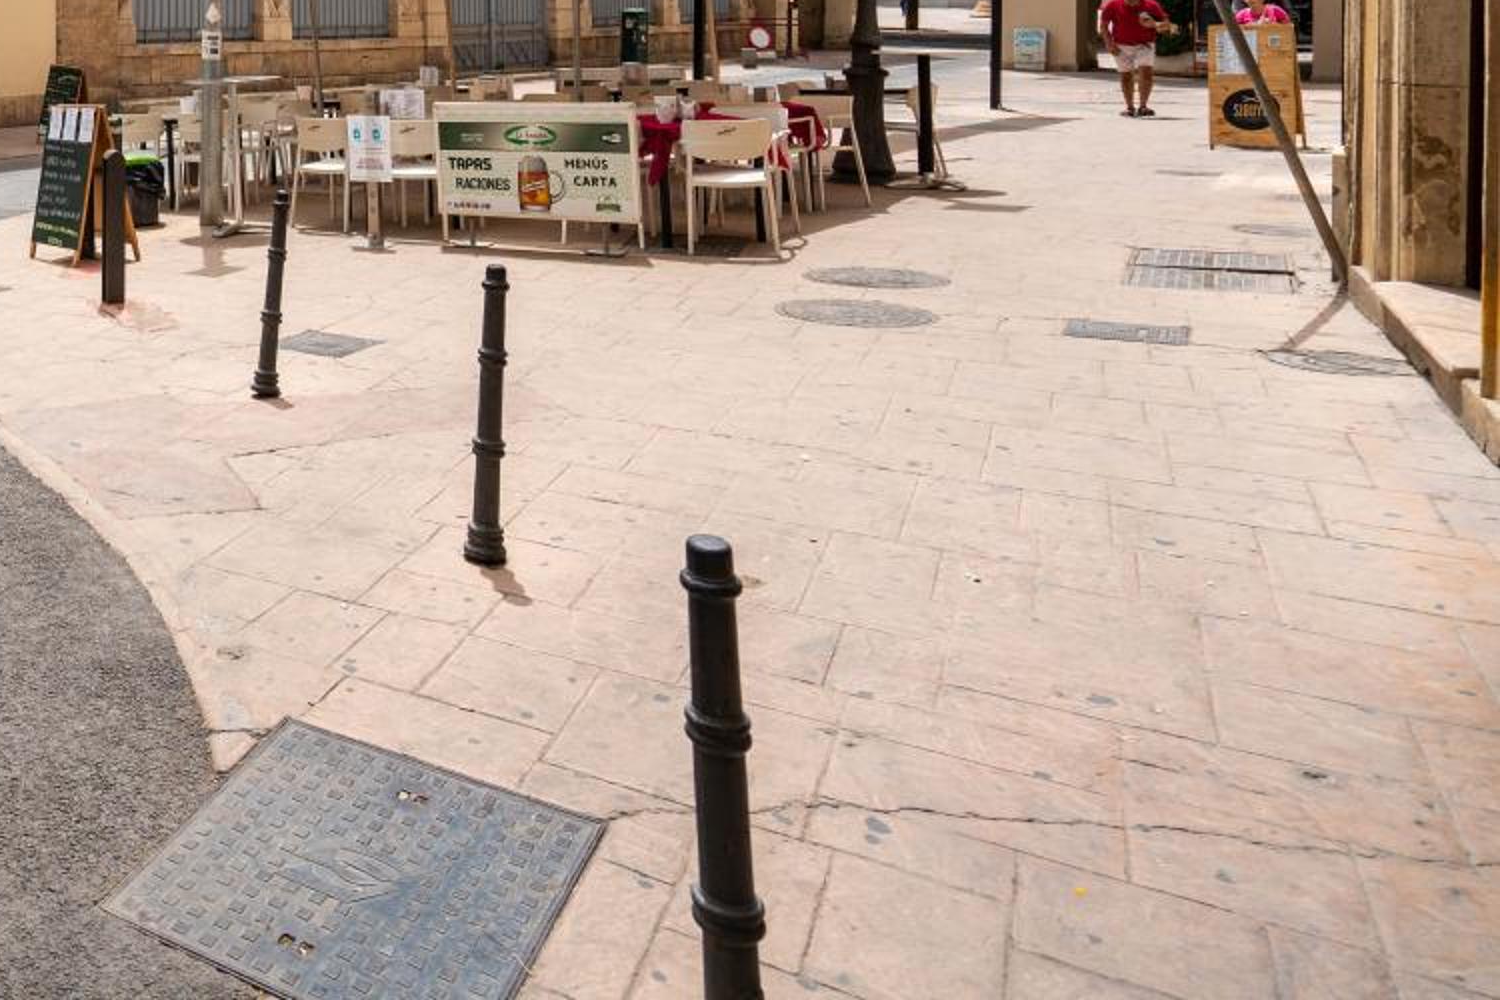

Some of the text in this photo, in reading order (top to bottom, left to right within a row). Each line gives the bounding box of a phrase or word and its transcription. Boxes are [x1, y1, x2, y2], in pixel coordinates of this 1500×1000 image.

[448, 156, 609, 171] TAPAS MENÚS
[455, 177, 512, 191] RACIONES
[573, 175, 617, 188] CARTA
